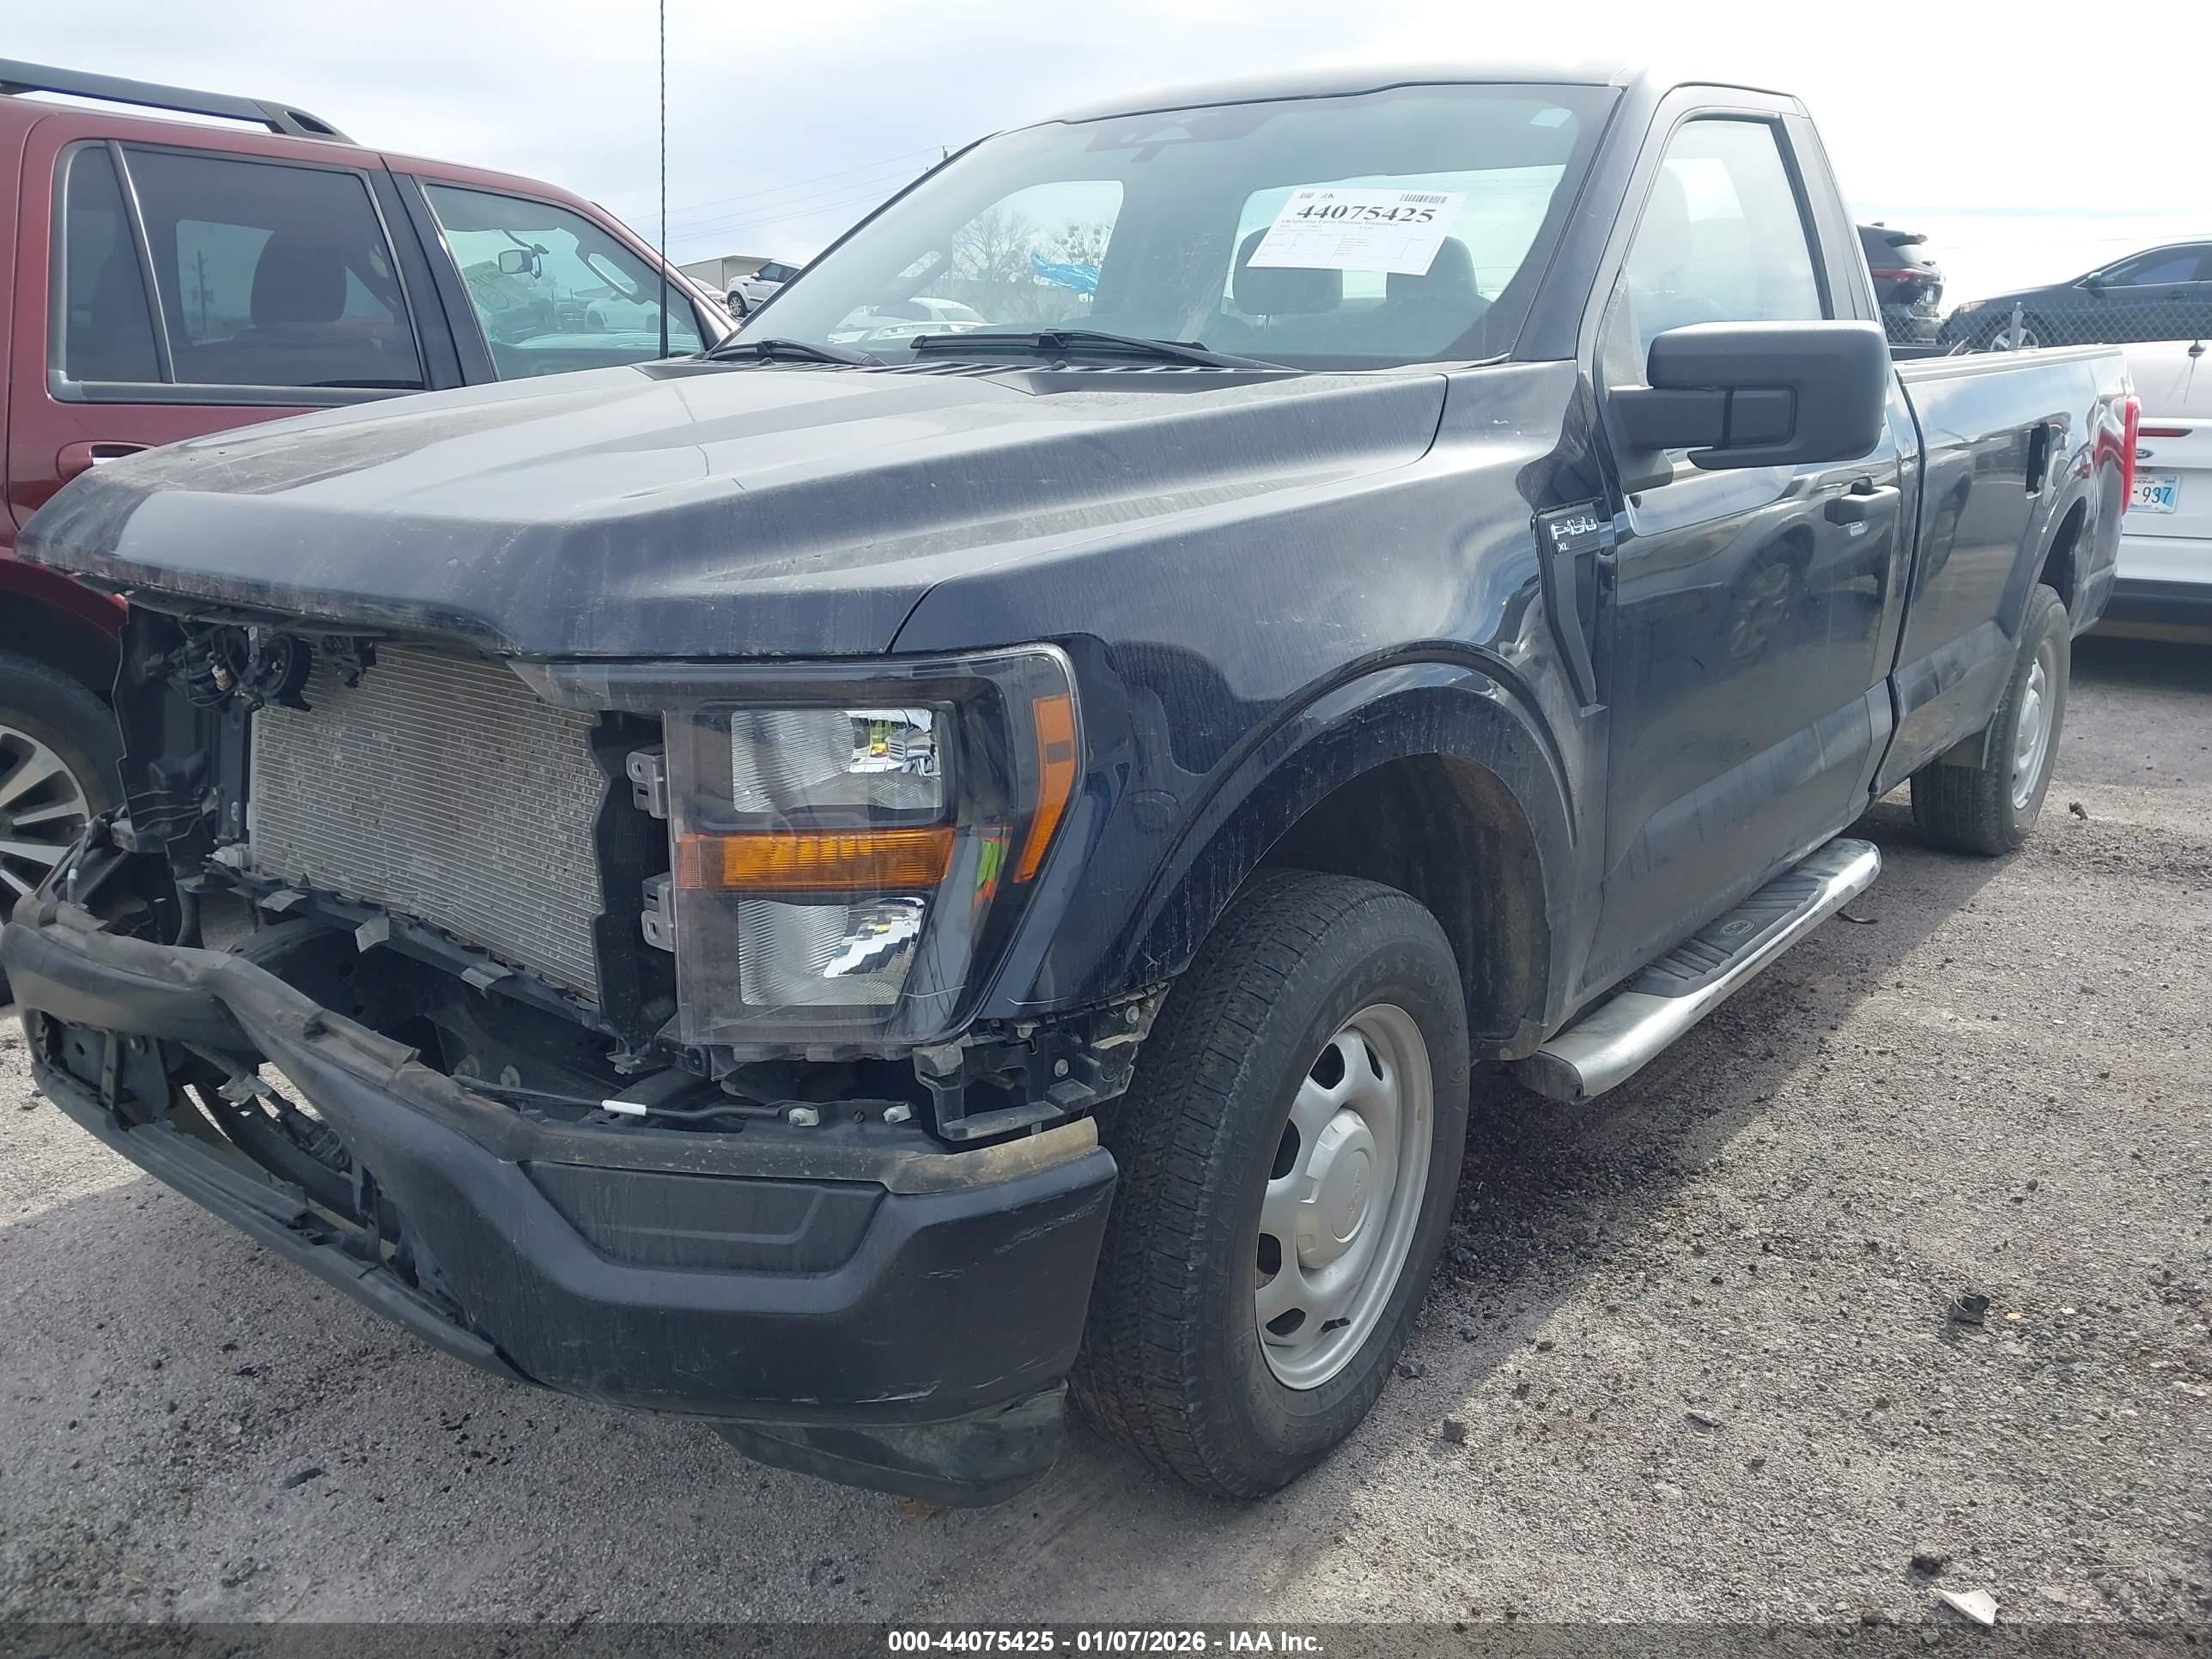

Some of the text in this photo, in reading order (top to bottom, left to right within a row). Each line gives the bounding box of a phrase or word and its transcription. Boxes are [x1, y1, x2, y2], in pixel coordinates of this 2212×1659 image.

[1297, 204, 1437, 223] 44075425
[1551, 516, 1597, 540] F-150
[1558, 542, 1570, 552] XL
